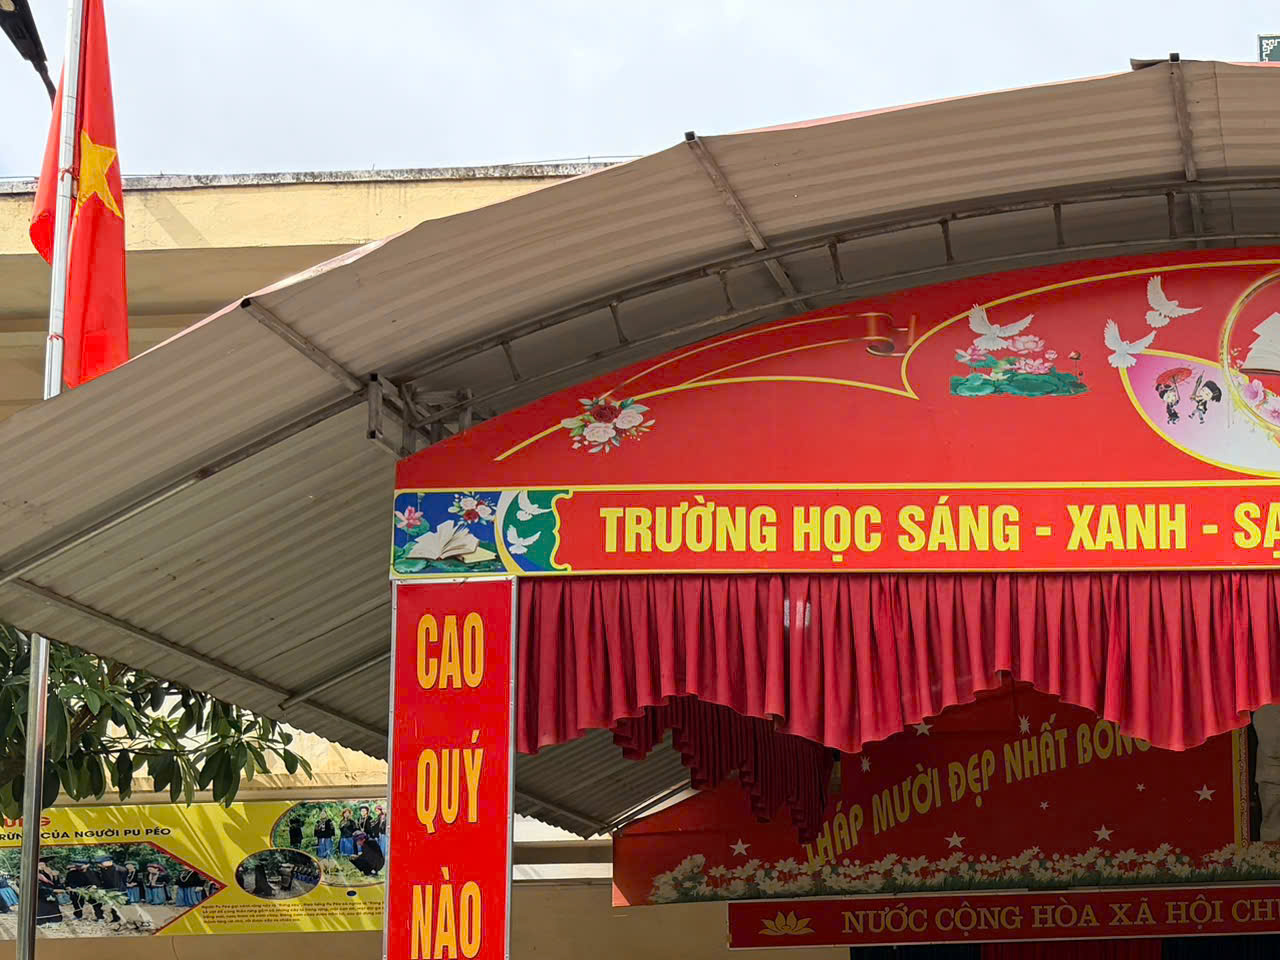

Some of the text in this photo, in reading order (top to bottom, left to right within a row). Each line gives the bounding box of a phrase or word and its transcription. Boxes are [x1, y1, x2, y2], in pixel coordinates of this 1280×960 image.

[600, 495, 776, 553] TRƯỜNG
[792, 506, 881, 562] HỌC
[897, 498, 1020, 552] SÁNG
[1066, 504, 1187, 551] XANH
[417, 612, 485, 689] CAO
[417, 730, 484, 834] QUÝ
[872, 763, 941, 836] MƯỜI
[948, 749, 996, 807] ĐẸP
[1003, 713, 1068, 784] NHẤT
[75, 829, 119, 838] NGƯỜI
[410, 868, 481, 960] NÀO
[843, 904, 927, 934] NƯỚC
[934, 901, 1023, 938] CỘNG
[1031, 898, 1100, 927] HÒA
[1108, 898, 1154, 925] XÃ
[1166, 893, 1222, 929] HỘI
